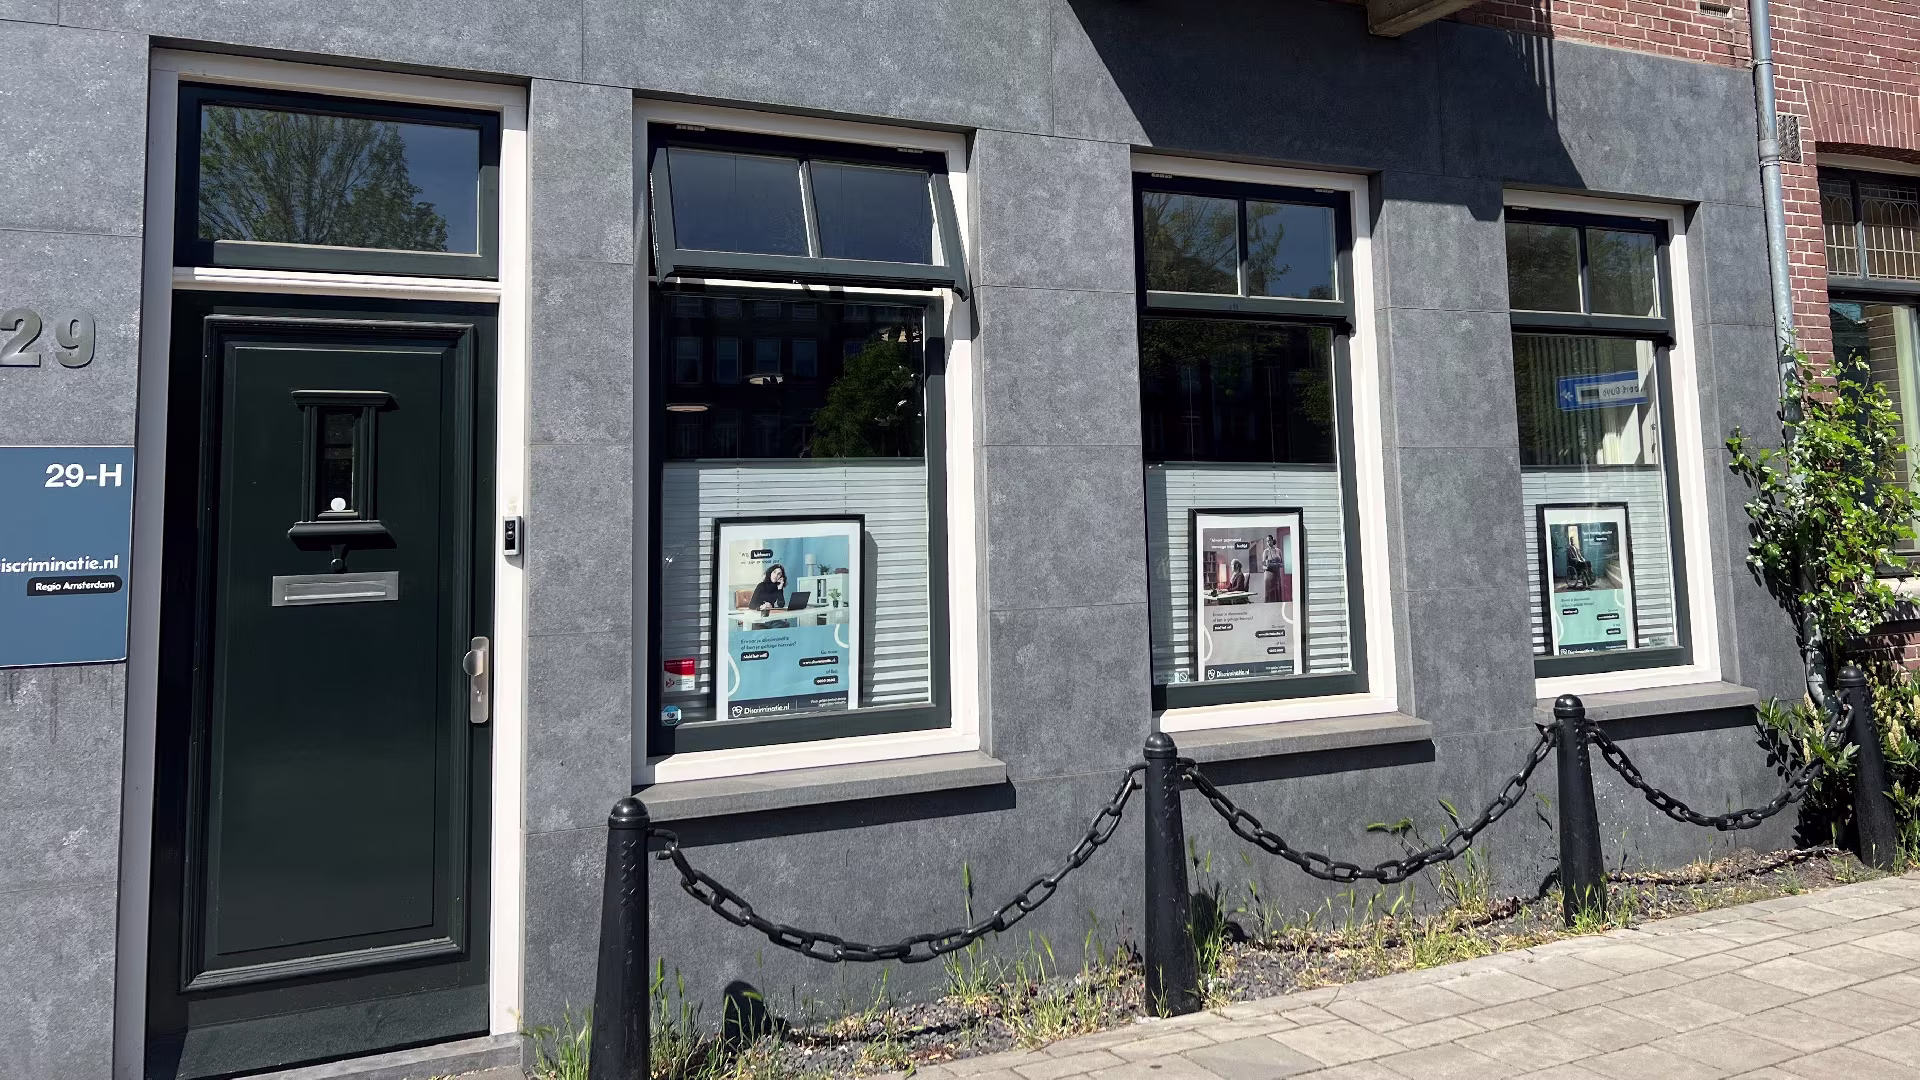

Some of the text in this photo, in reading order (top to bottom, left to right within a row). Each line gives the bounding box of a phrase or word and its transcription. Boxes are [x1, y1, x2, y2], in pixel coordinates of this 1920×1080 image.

[0, 308, 95, 369] 29
[44, 463, 122, 488] 29-H
[0, 555, 119, 573] iscriminatie.nl
[35, 581, 115, 592] Regio Amsterdam
[743, 703, 790, 715] Discriminatie.nl
